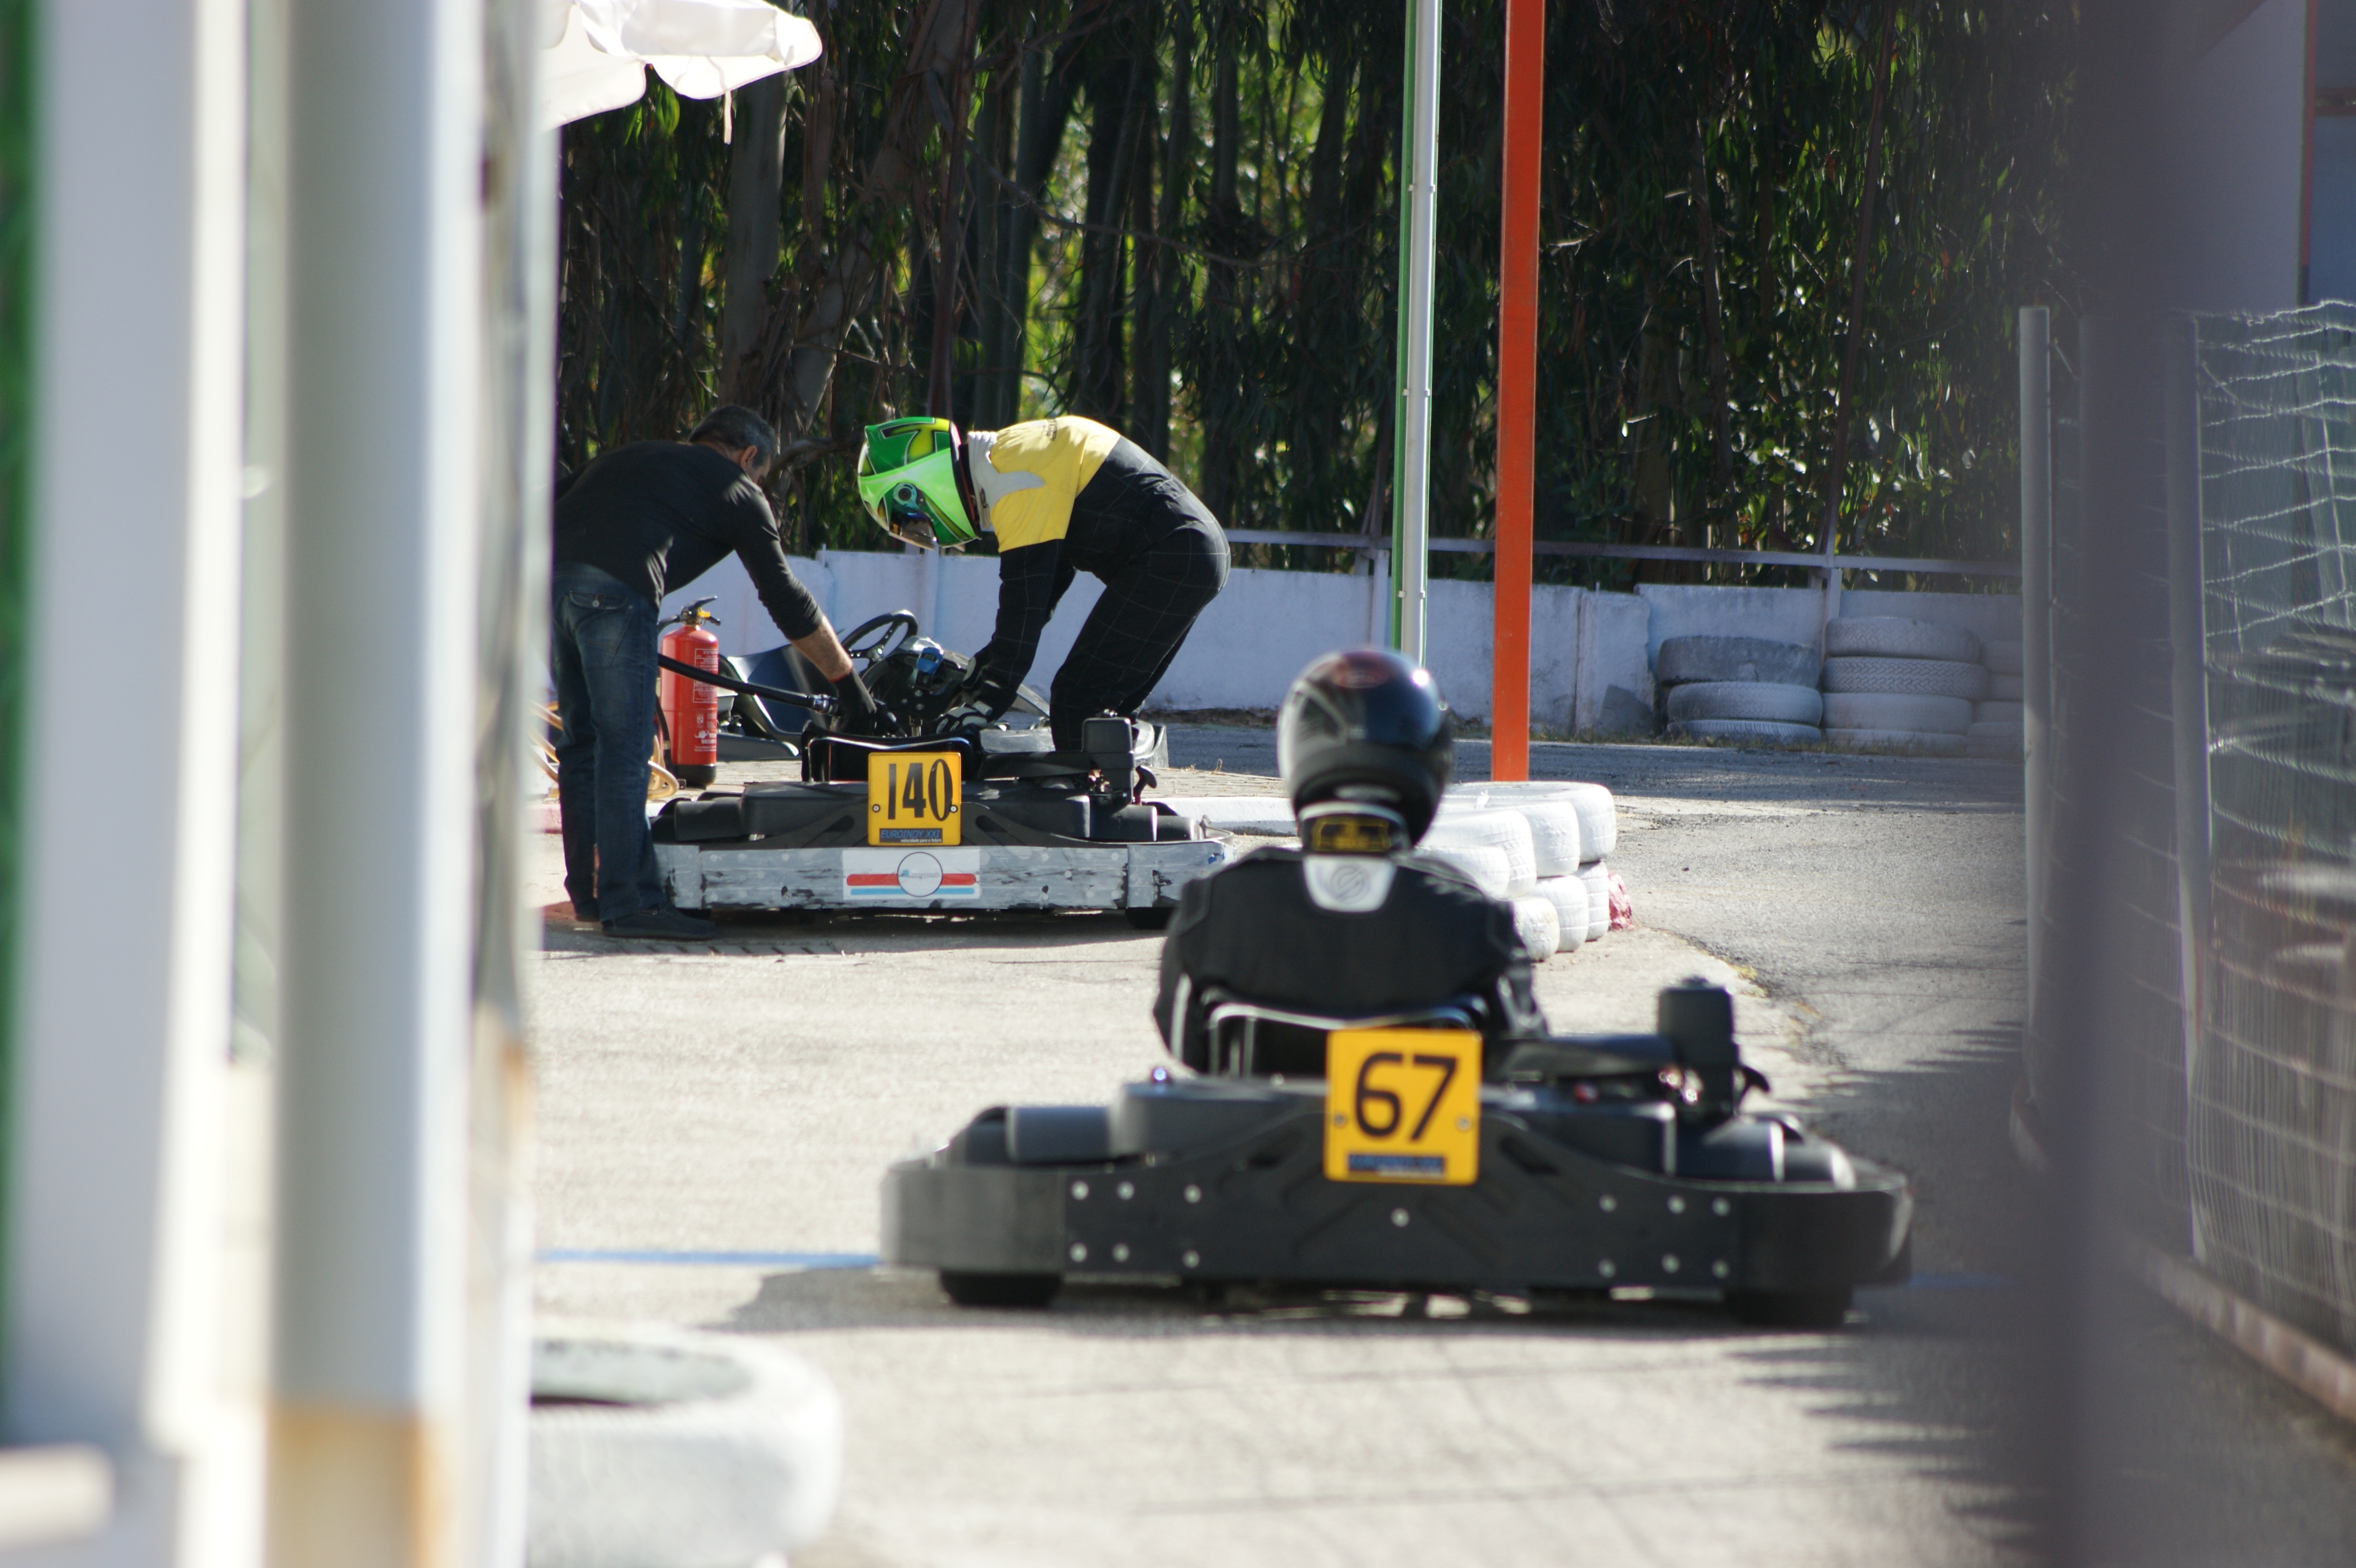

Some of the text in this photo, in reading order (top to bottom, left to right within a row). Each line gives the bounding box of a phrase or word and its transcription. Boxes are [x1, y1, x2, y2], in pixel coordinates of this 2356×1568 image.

[888, 758, 953, 821] 140
[881, 829, 939, 838] EUROINDY XXI
[1355, 1051, 1458, 1143] 67
